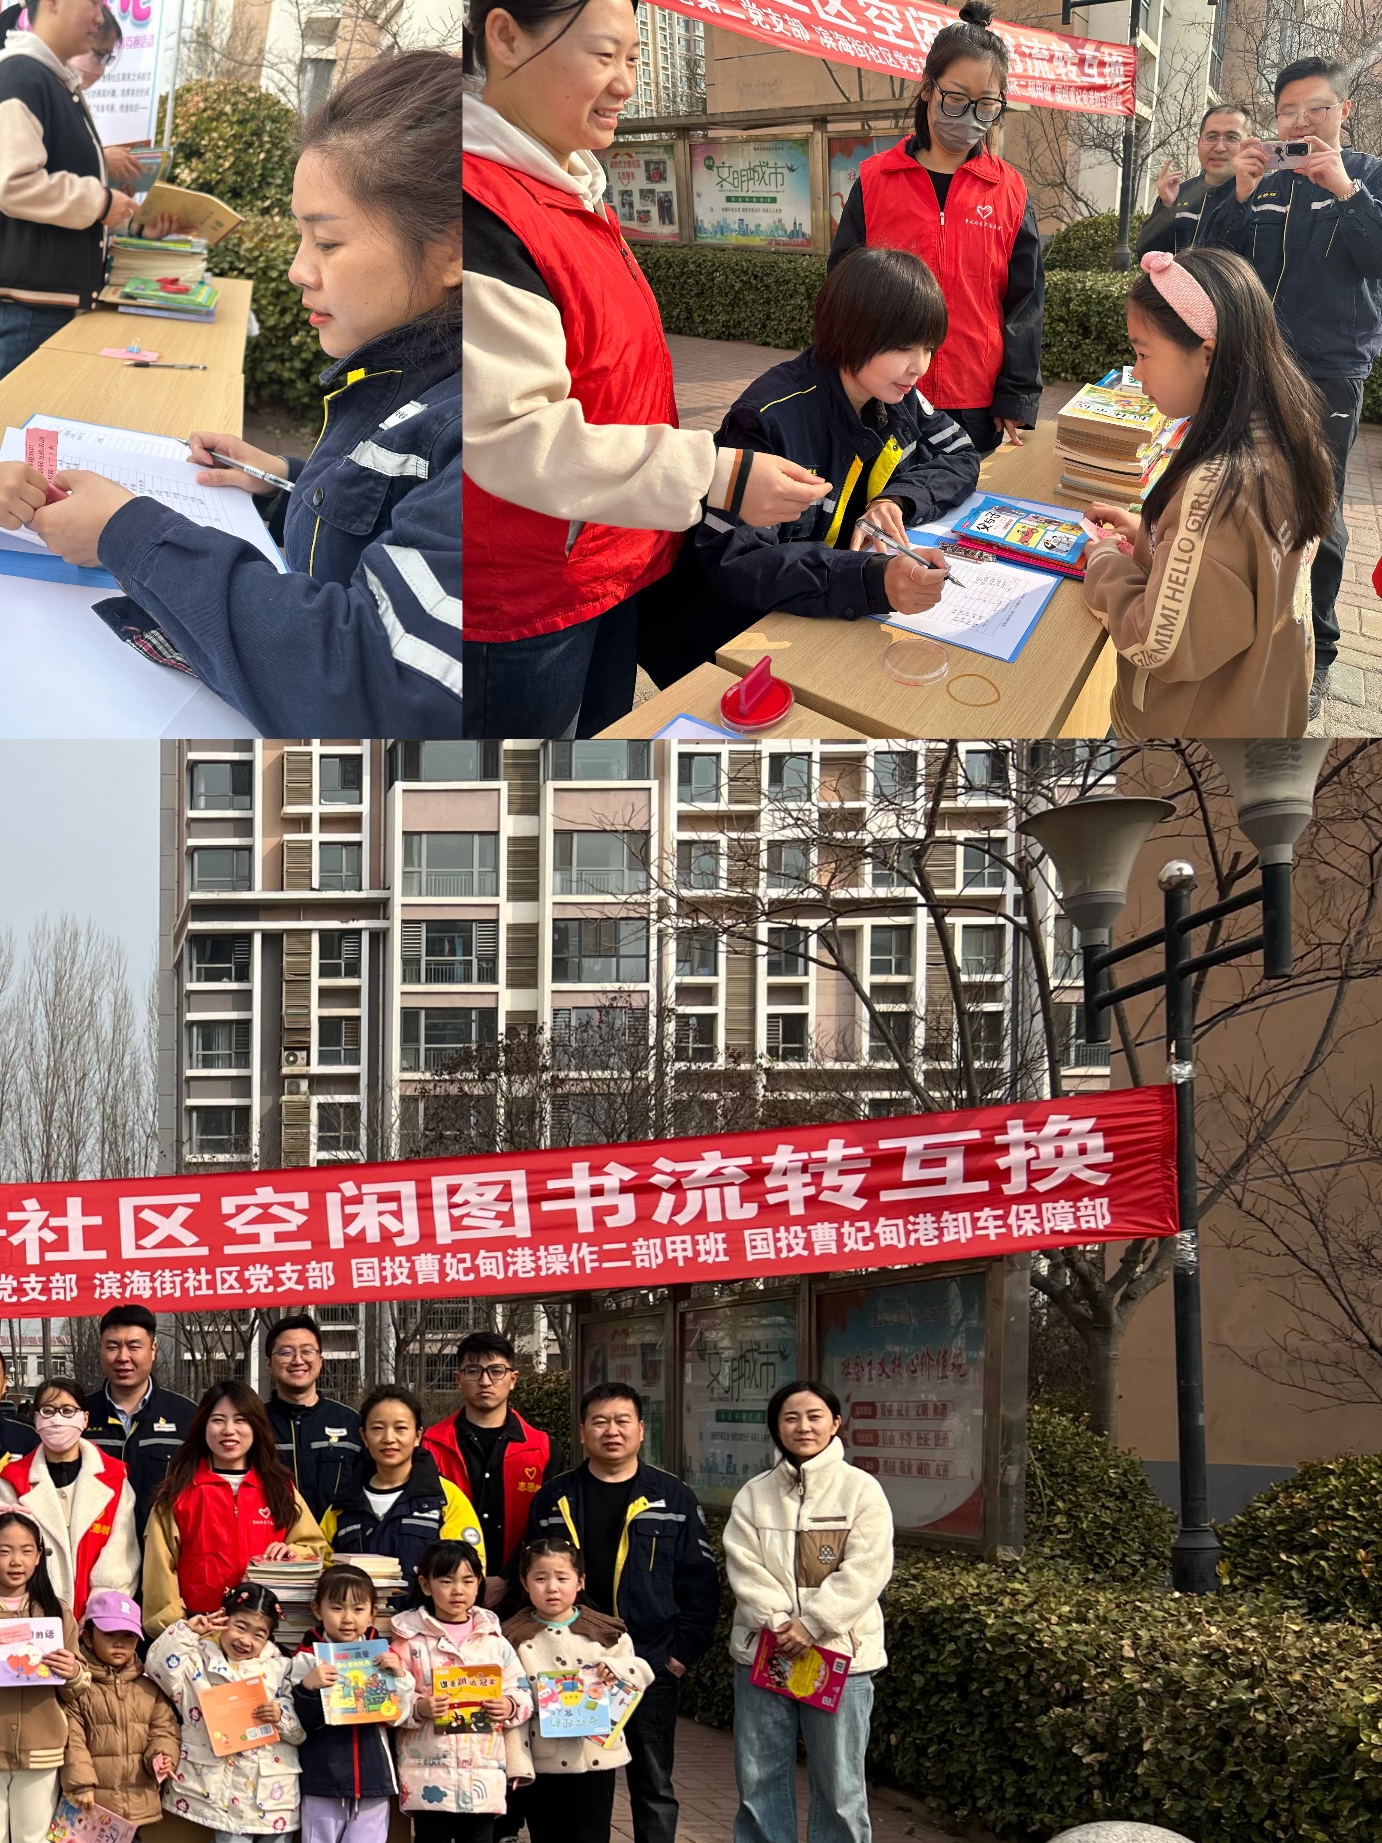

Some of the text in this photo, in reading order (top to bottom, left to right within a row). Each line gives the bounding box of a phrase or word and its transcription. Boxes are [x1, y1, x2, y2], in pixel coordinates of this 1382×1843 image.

[715, 161, 786, 193] 文明城市
[976, 511, 1002, 533] 父与子
[1184, 487, 1213, 534] GIRL
[1165, 536, 1196, 602] HELLO
[1151, 606, 1180, 657] MIMI
[92, 1262, 336, 1302] 滨海街社区党支部
[350, 1231, 728, 1289] 国投曹妃甸港操作二部甲班
[743, 1197, 1112, 1262] 国投曹妃甸港卸车保障部
[841, 1344, 968, 1382] 社会主义核心价值观
